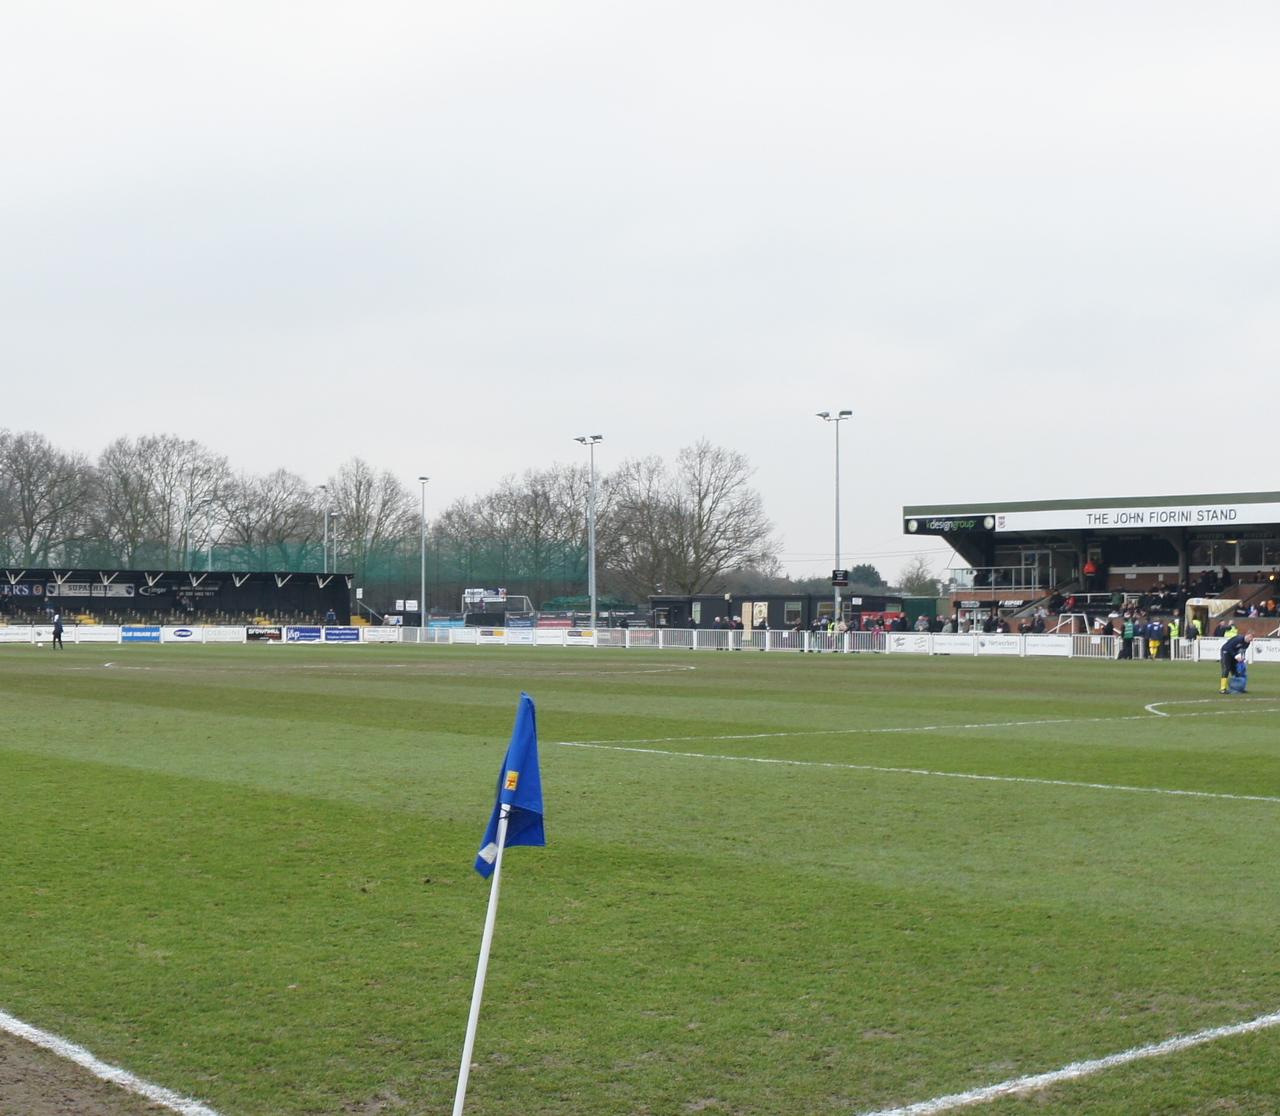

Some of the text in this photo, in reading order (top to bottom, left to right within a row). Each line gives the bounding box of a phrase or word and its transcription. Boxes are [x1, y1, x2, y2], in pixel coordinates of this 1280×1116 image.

[1086, 509, 1237, 525] THE JOHN FIORINI STAND
